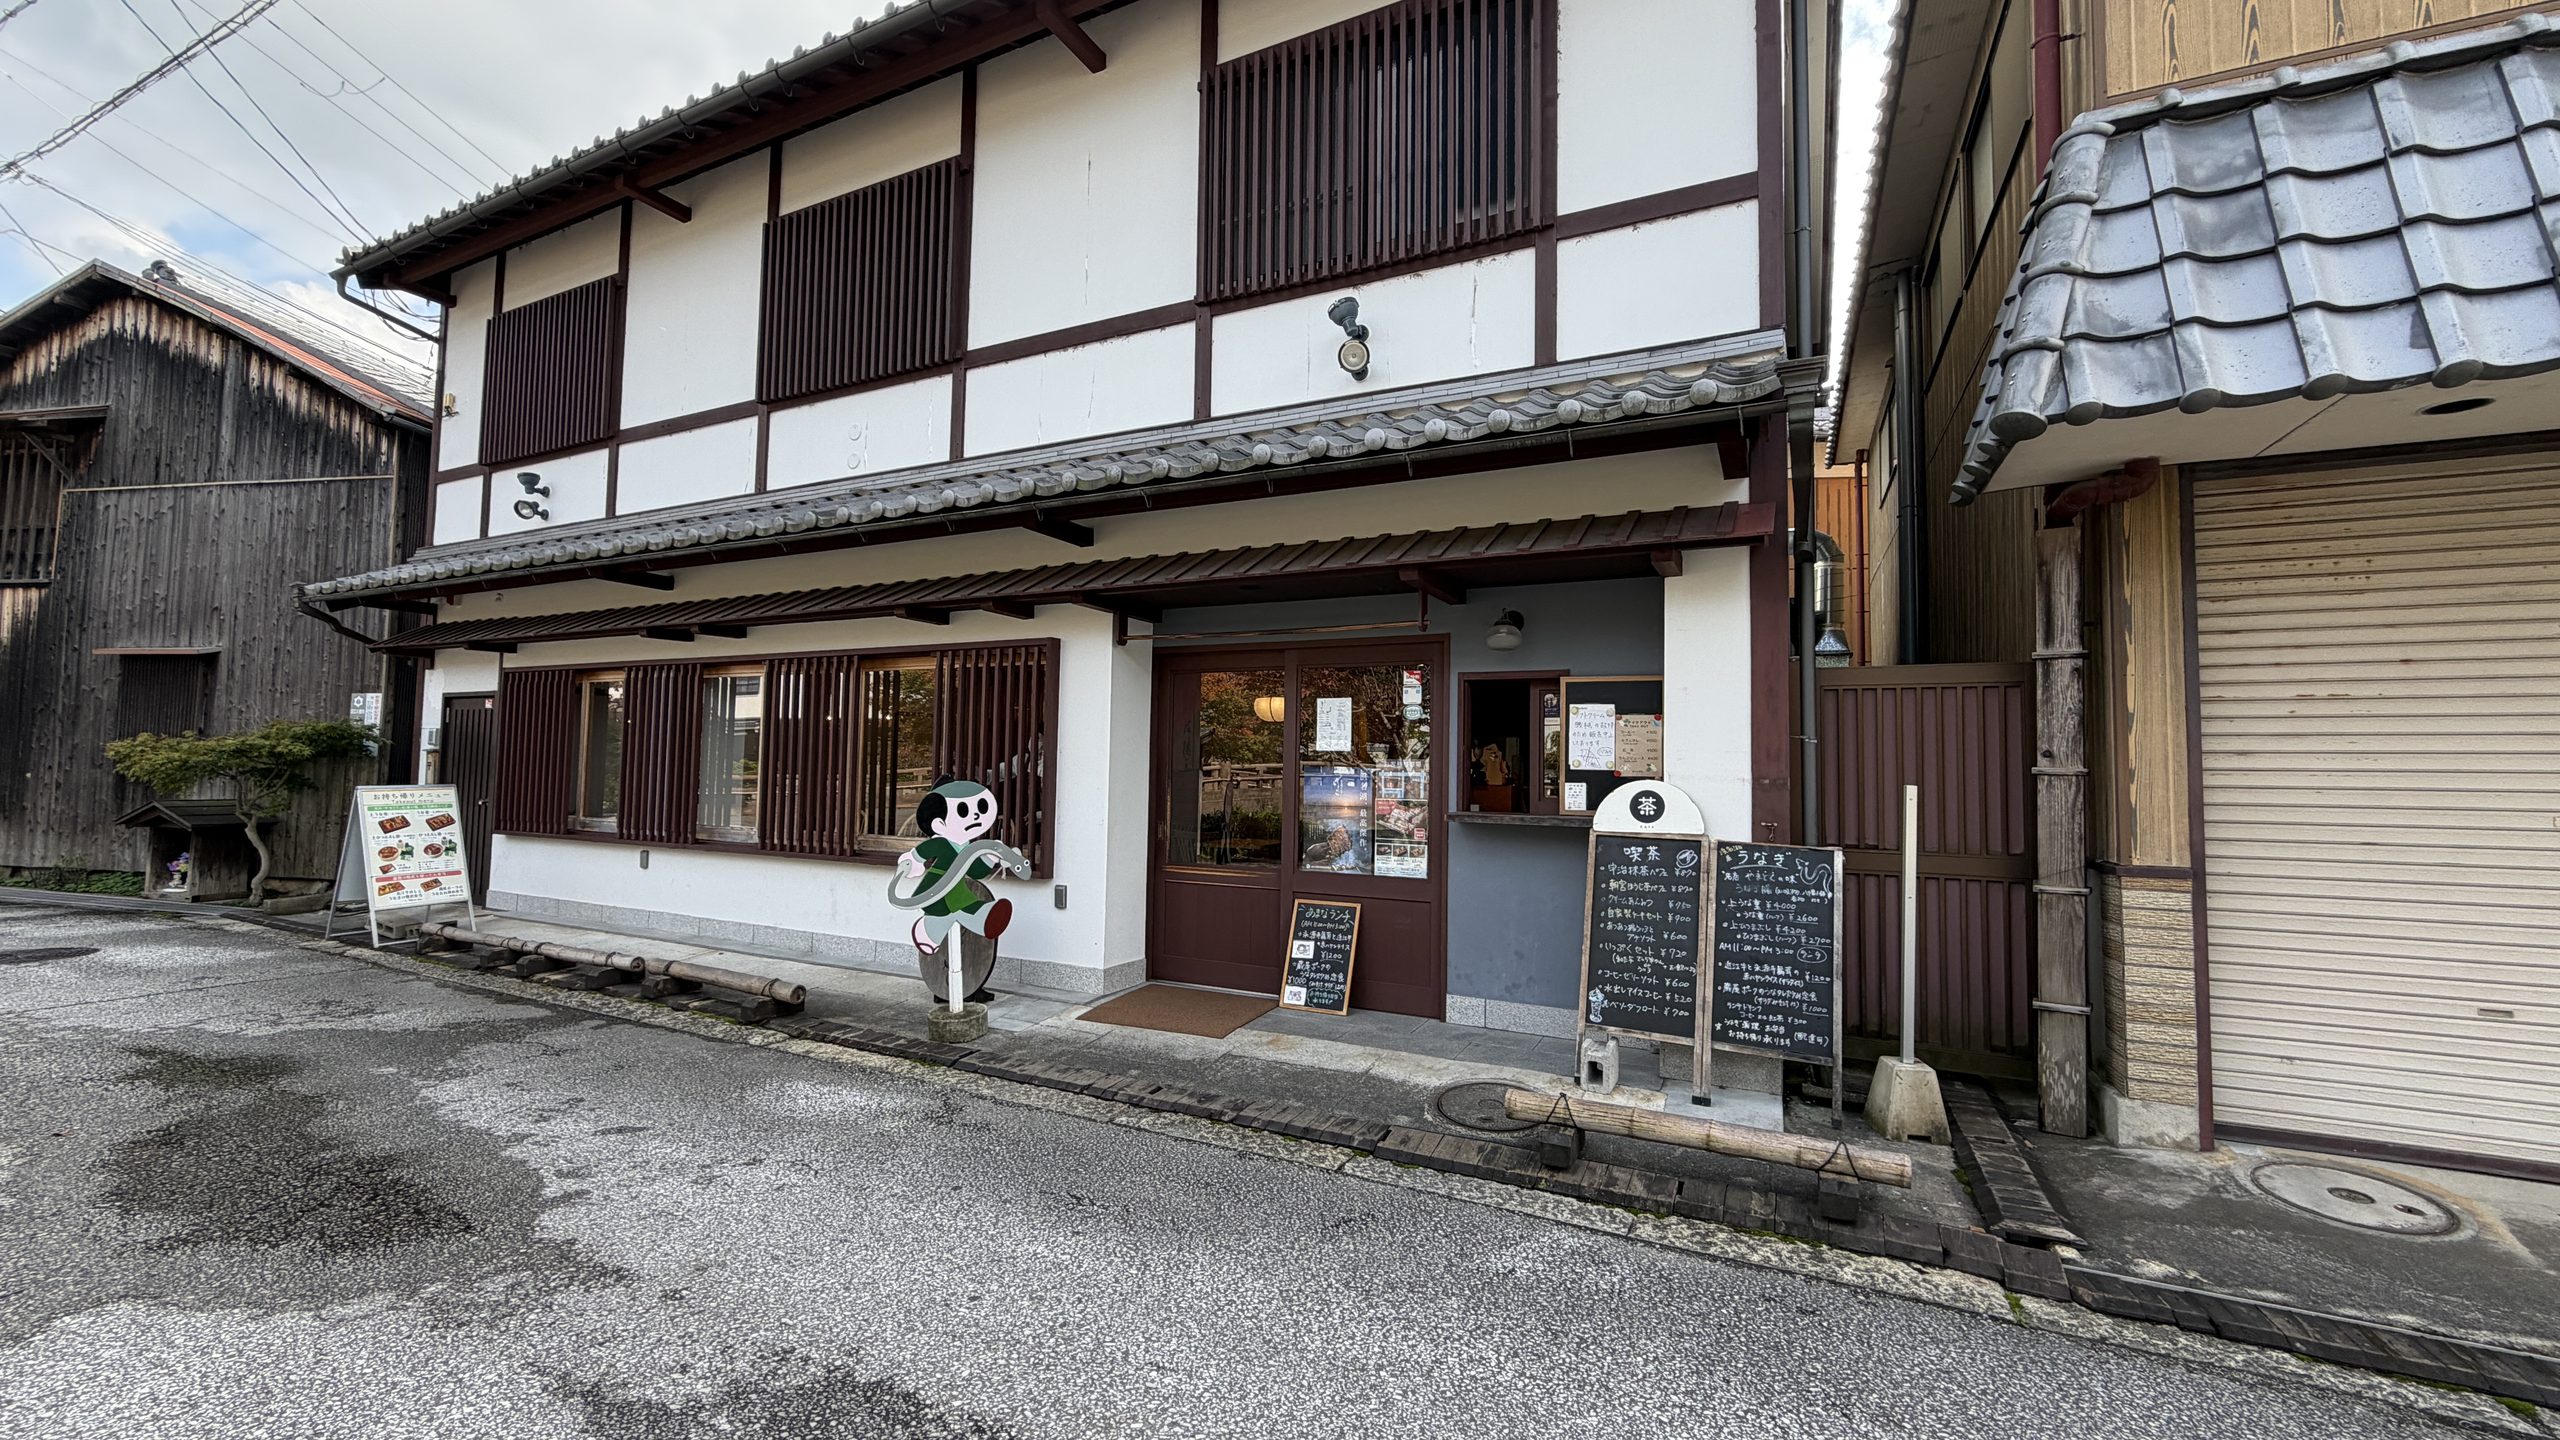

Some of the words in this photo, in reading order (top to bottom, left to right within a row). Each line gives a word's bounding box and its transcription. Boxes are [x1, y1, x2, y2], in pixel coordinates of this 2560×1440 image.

[373, 792, 450, 800] お持ち帰りメニュー
[1638, 796, 1658, 816] 茶
[1623, 846, 1660, 862] 喫茶
[1738, 850, 1792, 867] うなぎ
[1608, 862, 1668, 876] 宇治抹茶パフェ
[1766, 900, 1796, 910] ¥4000
[1668, 913, 1691, 924] ¥900
[1789, 913, 1818, 921] ¥2600
[1776, 924, 1806, 934] ¥4200
[1663, 931, 1687, 940] ¥600
[1801, 935, 1831, 945] ¥2700
[1321, 951, 1342, 959] ¥1200
[1660, 948, 1687, 959] ¥720
[1288, 976, 1306, 984] ¥1000
[1604, 970, 1659, 985] コーヒーゼリーソフト
[1664, 978, 1690, 987] ¥600
[1805, 971, 1831, 981] ¥1200
[1665, 992, 1692, 1002] ¥520
[1664, 1007, 1689, 1017] ¥700
[1802, 1003, 1827, 1013] ¥1000
